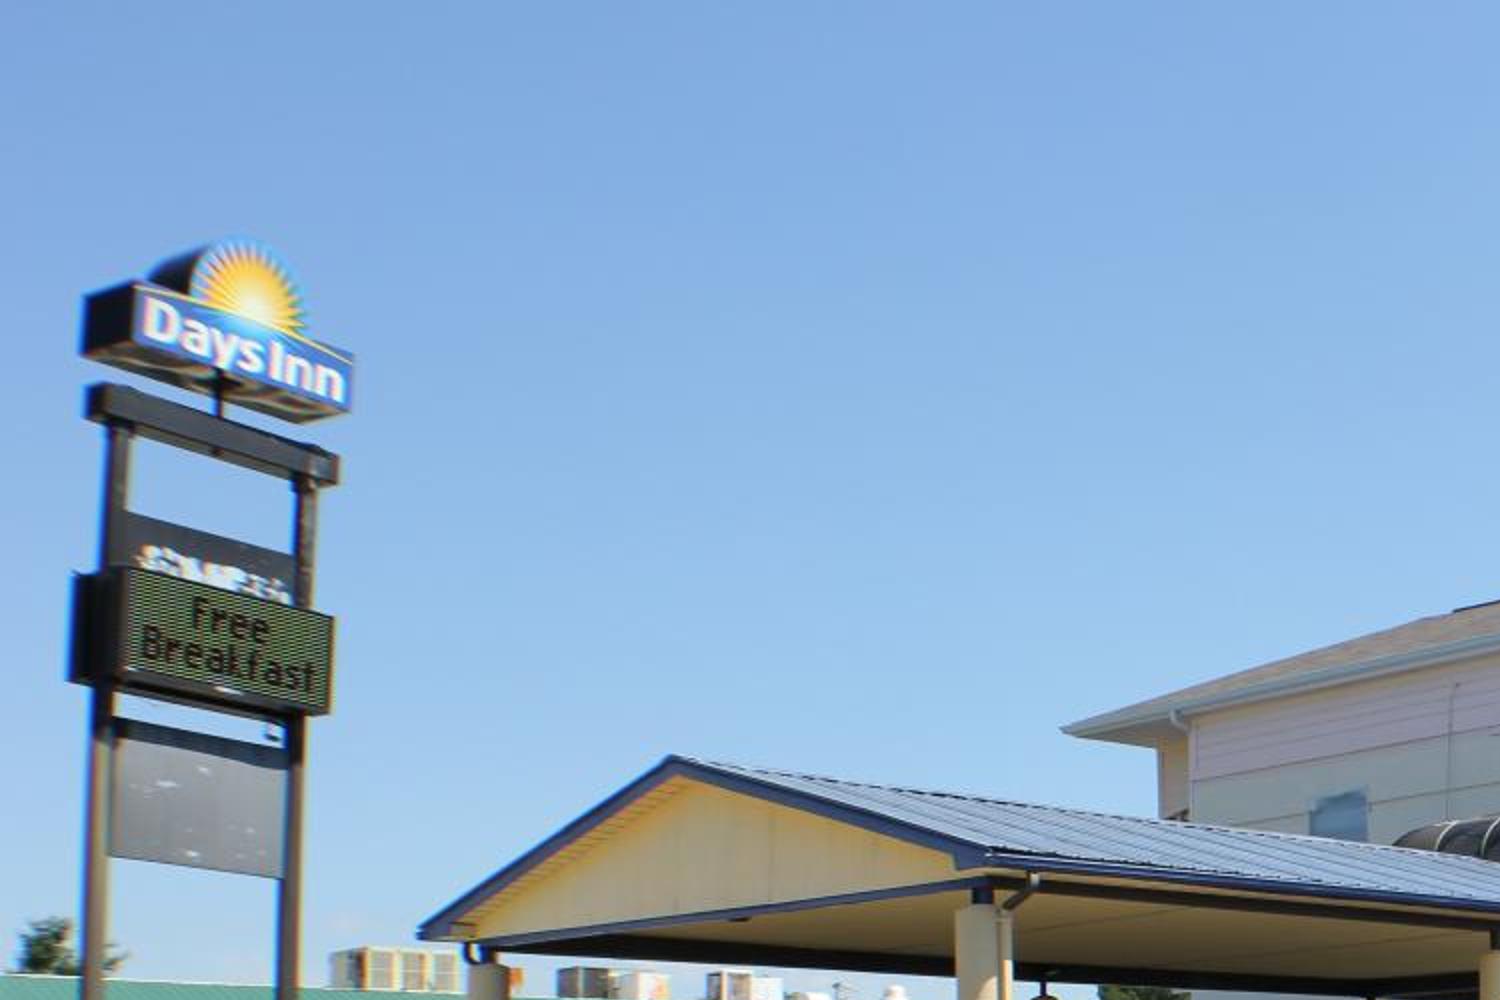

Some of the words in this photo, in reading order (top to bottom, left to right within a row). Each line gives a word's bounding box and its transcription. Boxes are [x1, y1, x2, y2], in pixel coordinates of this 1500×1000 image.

[142, 294, 265, 371] Days
[268, 340, 345, 404] Inn
[192, 596, 270, 642] Free
[143, 624, 317, 693] Breakfast
